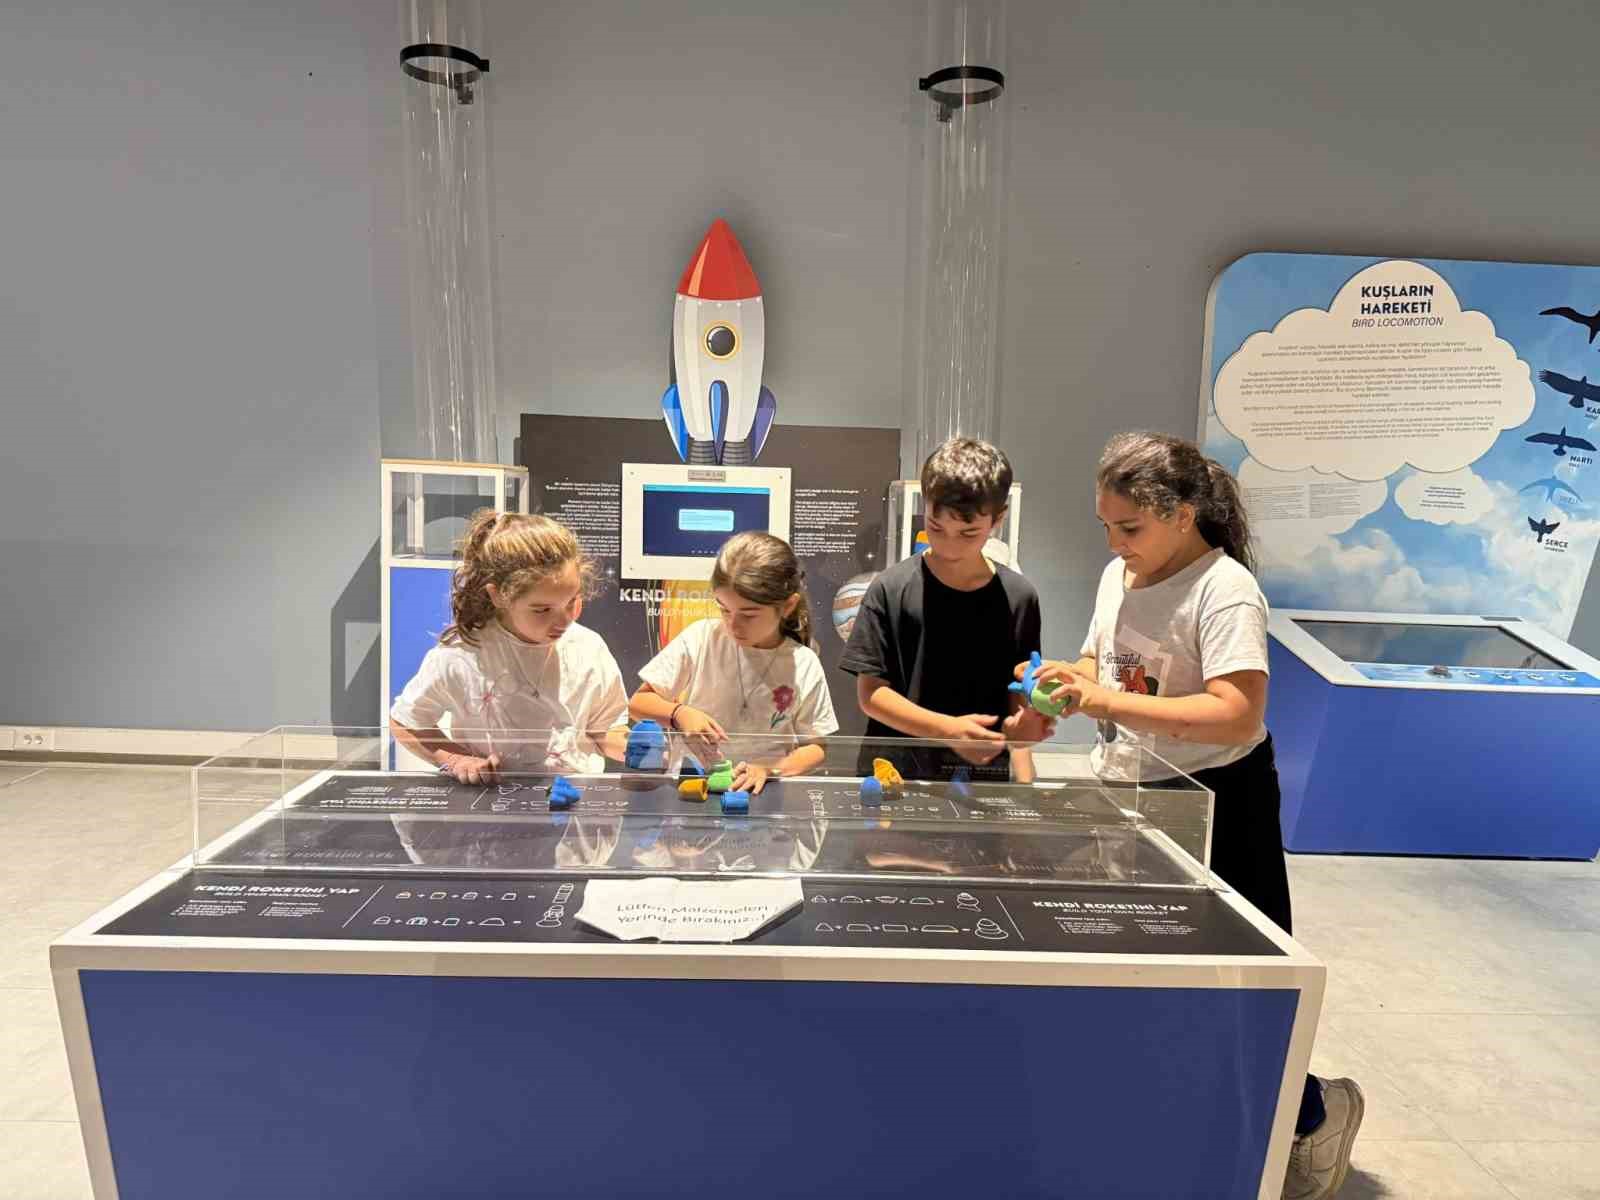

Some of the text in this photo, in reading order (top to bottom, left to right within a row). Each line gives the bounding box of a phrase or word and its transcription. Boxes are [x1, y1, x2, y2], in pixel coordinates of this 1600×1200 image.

[1361, 285, 1433, 300] KUŞLARIN
[1361, 299, 1431, 314] HAREKETİ
[1352, 317, 1444, 328] BIRD LOCOMOTION
[619, 588, 671, 602] KENDİ
[247, 885, 324, 893] ROKETİNİ
[328, 887, 360, 895] YAP
[616, 903, 667, 912] Lütfen
[1083, 902, 1156, 911] ROKETİNİ
